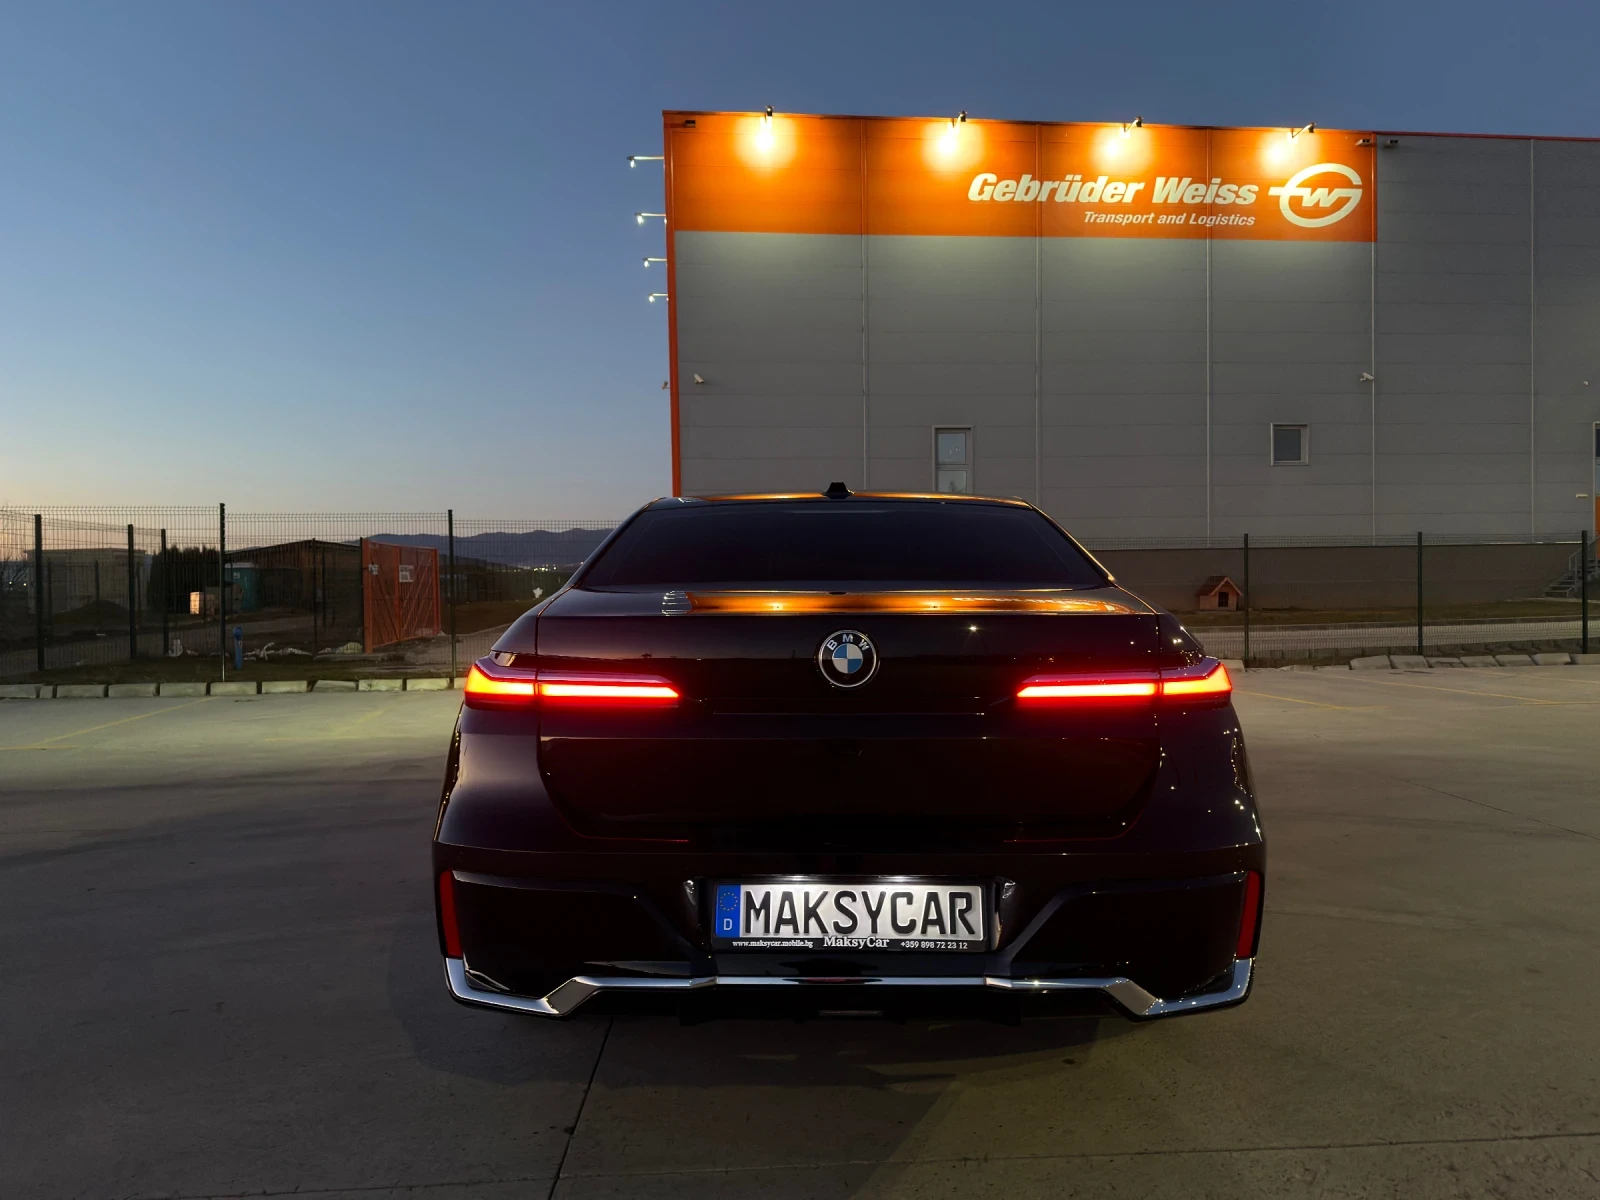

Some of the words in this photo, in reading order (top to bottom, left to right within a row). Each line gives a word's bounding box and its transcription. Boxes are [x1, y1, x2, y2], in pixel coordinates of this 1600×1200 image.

[968, 173, 1146, 204] Gebrüder
[1152, 177, 1259, 205] Weiss
[1084, 211, 1156, 227] Transport
[1157, 213, 1186, 225] and
[1189, 213, 1256, 227] Logistics
[826, 633, 870, 651] BMW
[744, 890, 975, 935] MAKSYCAR
[723, 918, 733, 931] D
[732, 940, 814, 948] www.maksycar.mobile.bg
[823, 935, 889, 949] MaksyCar
[900, 940, 919, 948] +359
